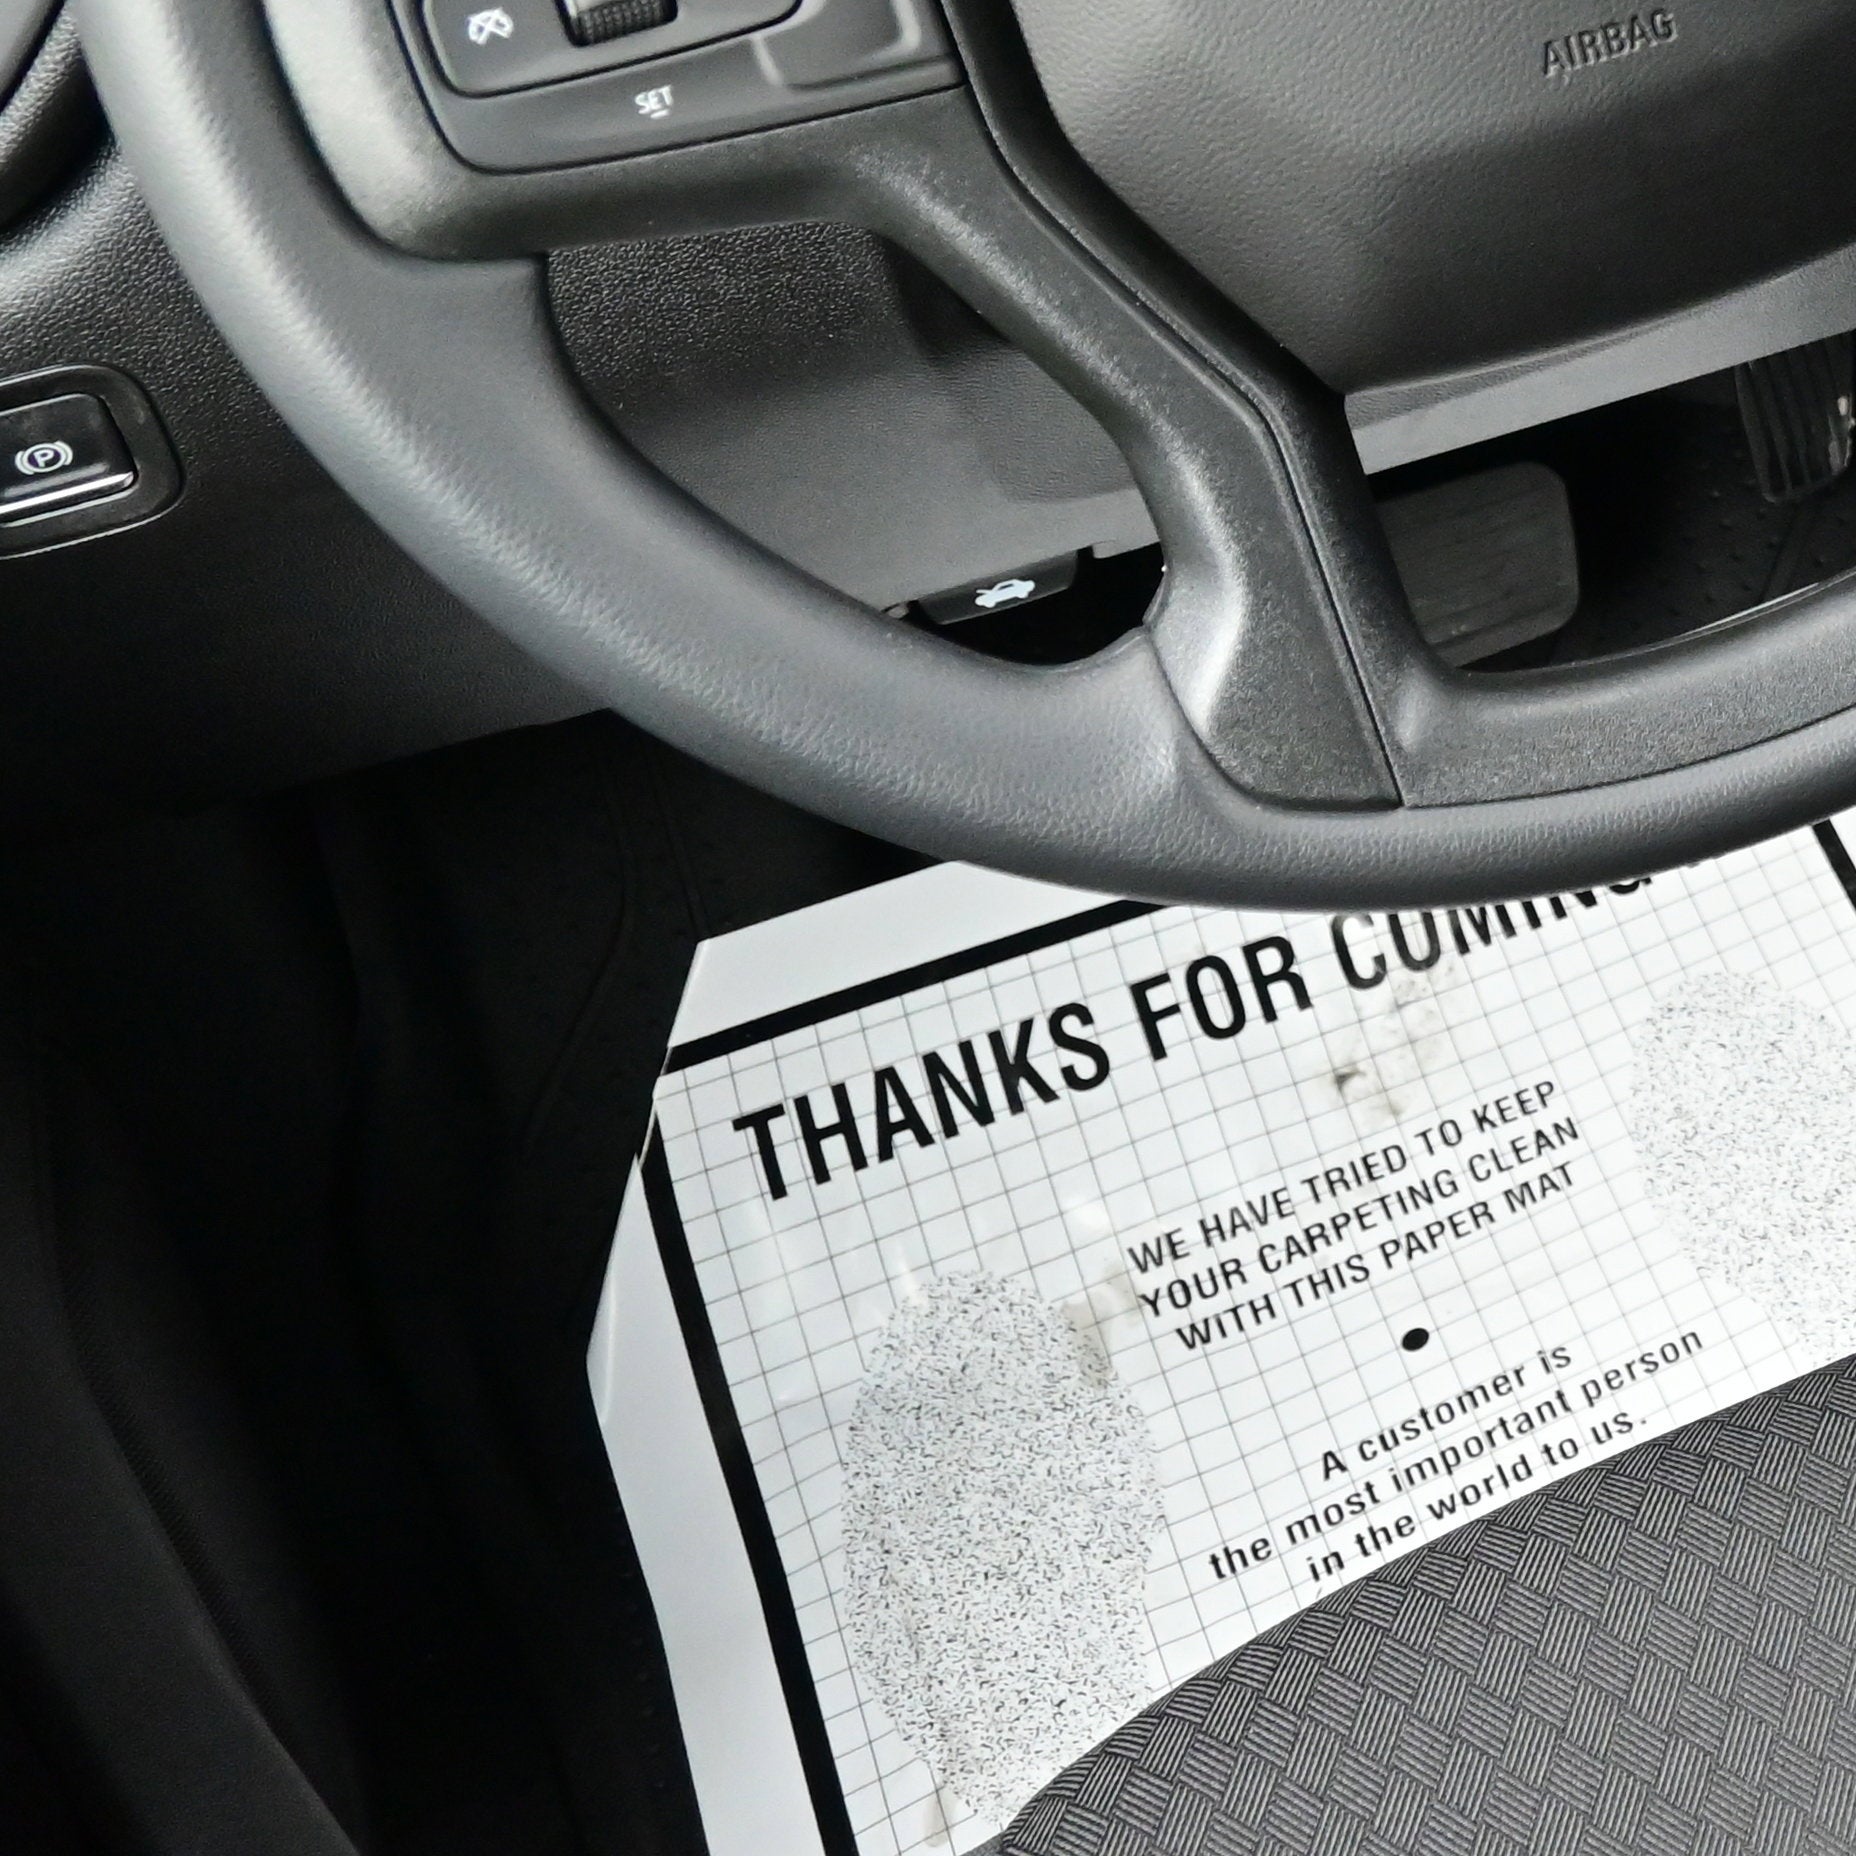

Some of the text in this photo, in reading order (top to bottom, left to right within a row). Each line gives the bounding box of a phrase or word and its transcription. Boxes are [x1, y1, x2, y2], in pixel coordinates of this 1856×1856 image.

[634, 85, 675, 115] SET
[1541, 7, 1678, 76] AIRBAG
[733, 1002, 1111, 1202] THANKS
[1131, 936, 1314, 1063] FOR
[1127, 1080, 1556, 1275] WE HAVE TRIED TO KEEP
[1138, 1116, 1580, 1319] YOUR CARPETING CLEAN
[1175, 1161, 1576, 1351] WITH THIS PAPER MAT
[1208, 1329, 1704, 1580] the most important person
[1305, 1407, 1648, 1582] in the world to us.
[1321, 1344, 1573, 1481] A customer is
